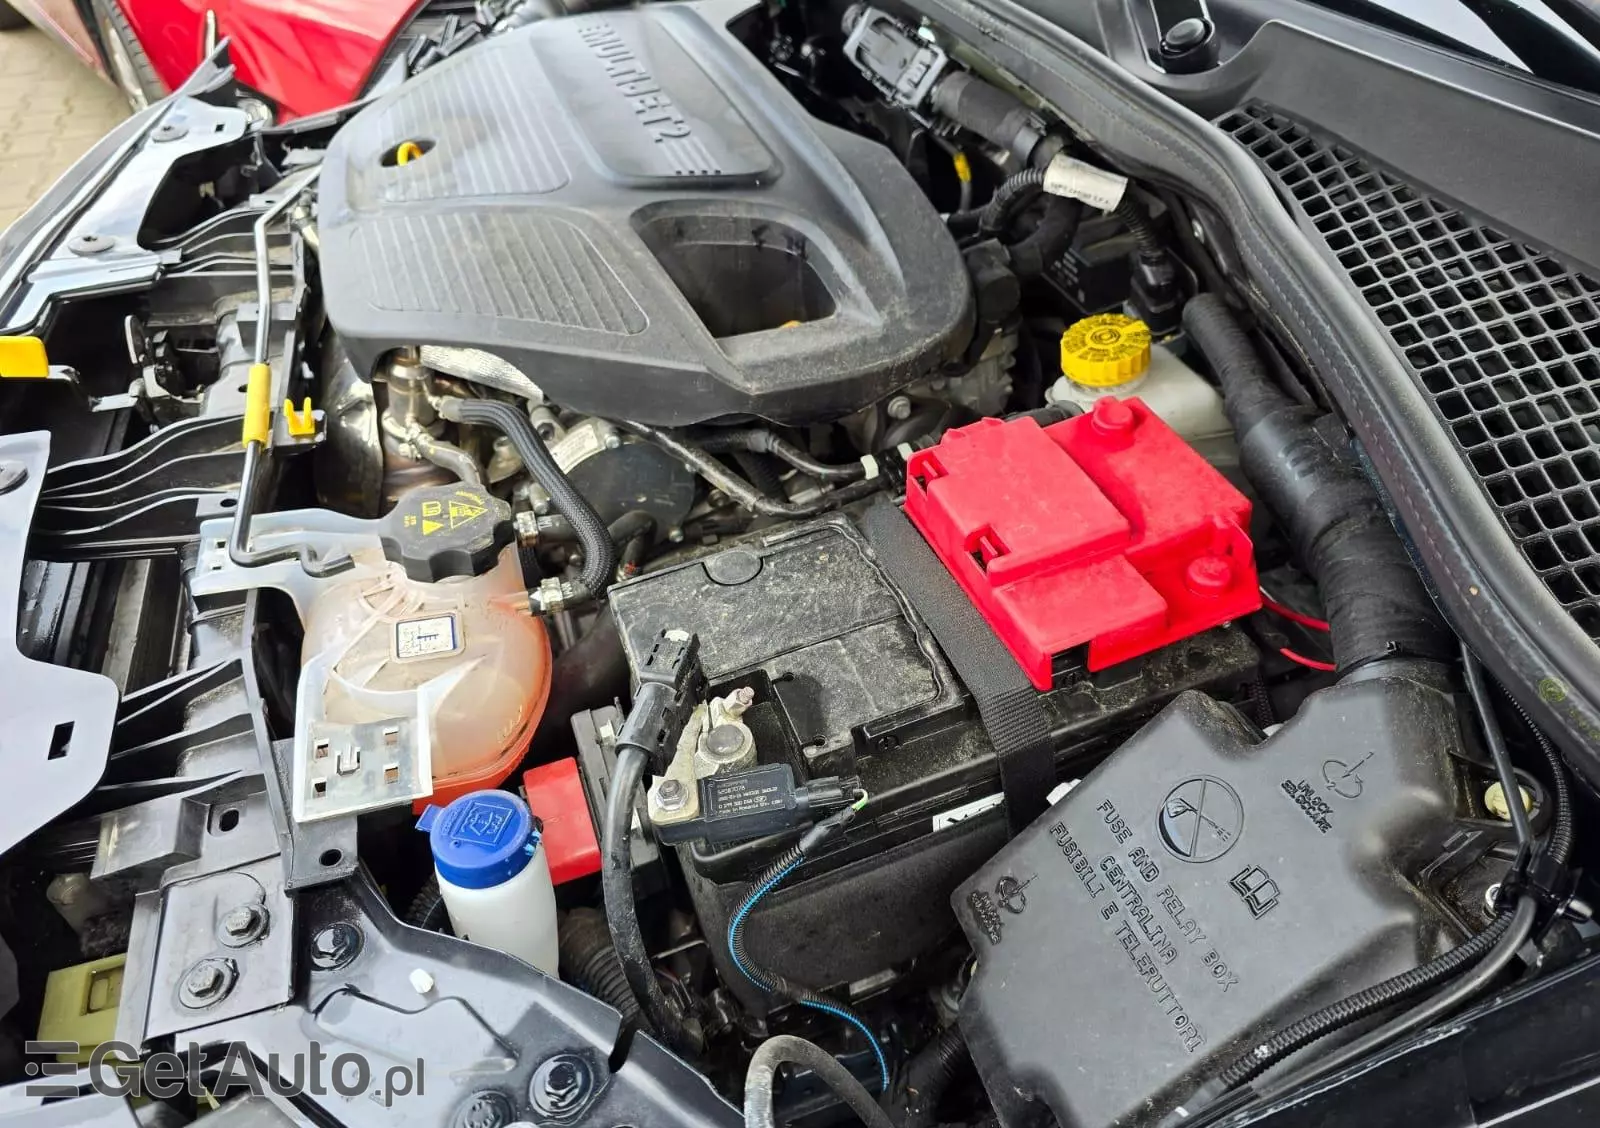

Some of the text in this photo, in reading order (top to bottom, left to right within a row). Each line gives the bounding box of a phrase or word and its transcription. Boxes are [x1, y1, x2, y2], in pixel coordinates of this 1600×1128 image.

[1297, 779, 1334, 815] UNLOCK
[1050, 820, 1207, 1053] FUSIBILI E TELERUTTORI
[1096, 799, 1240, 993] FUSE AND RELAY BOX
[1099, 855, 1178, 966] CENTRALINA
